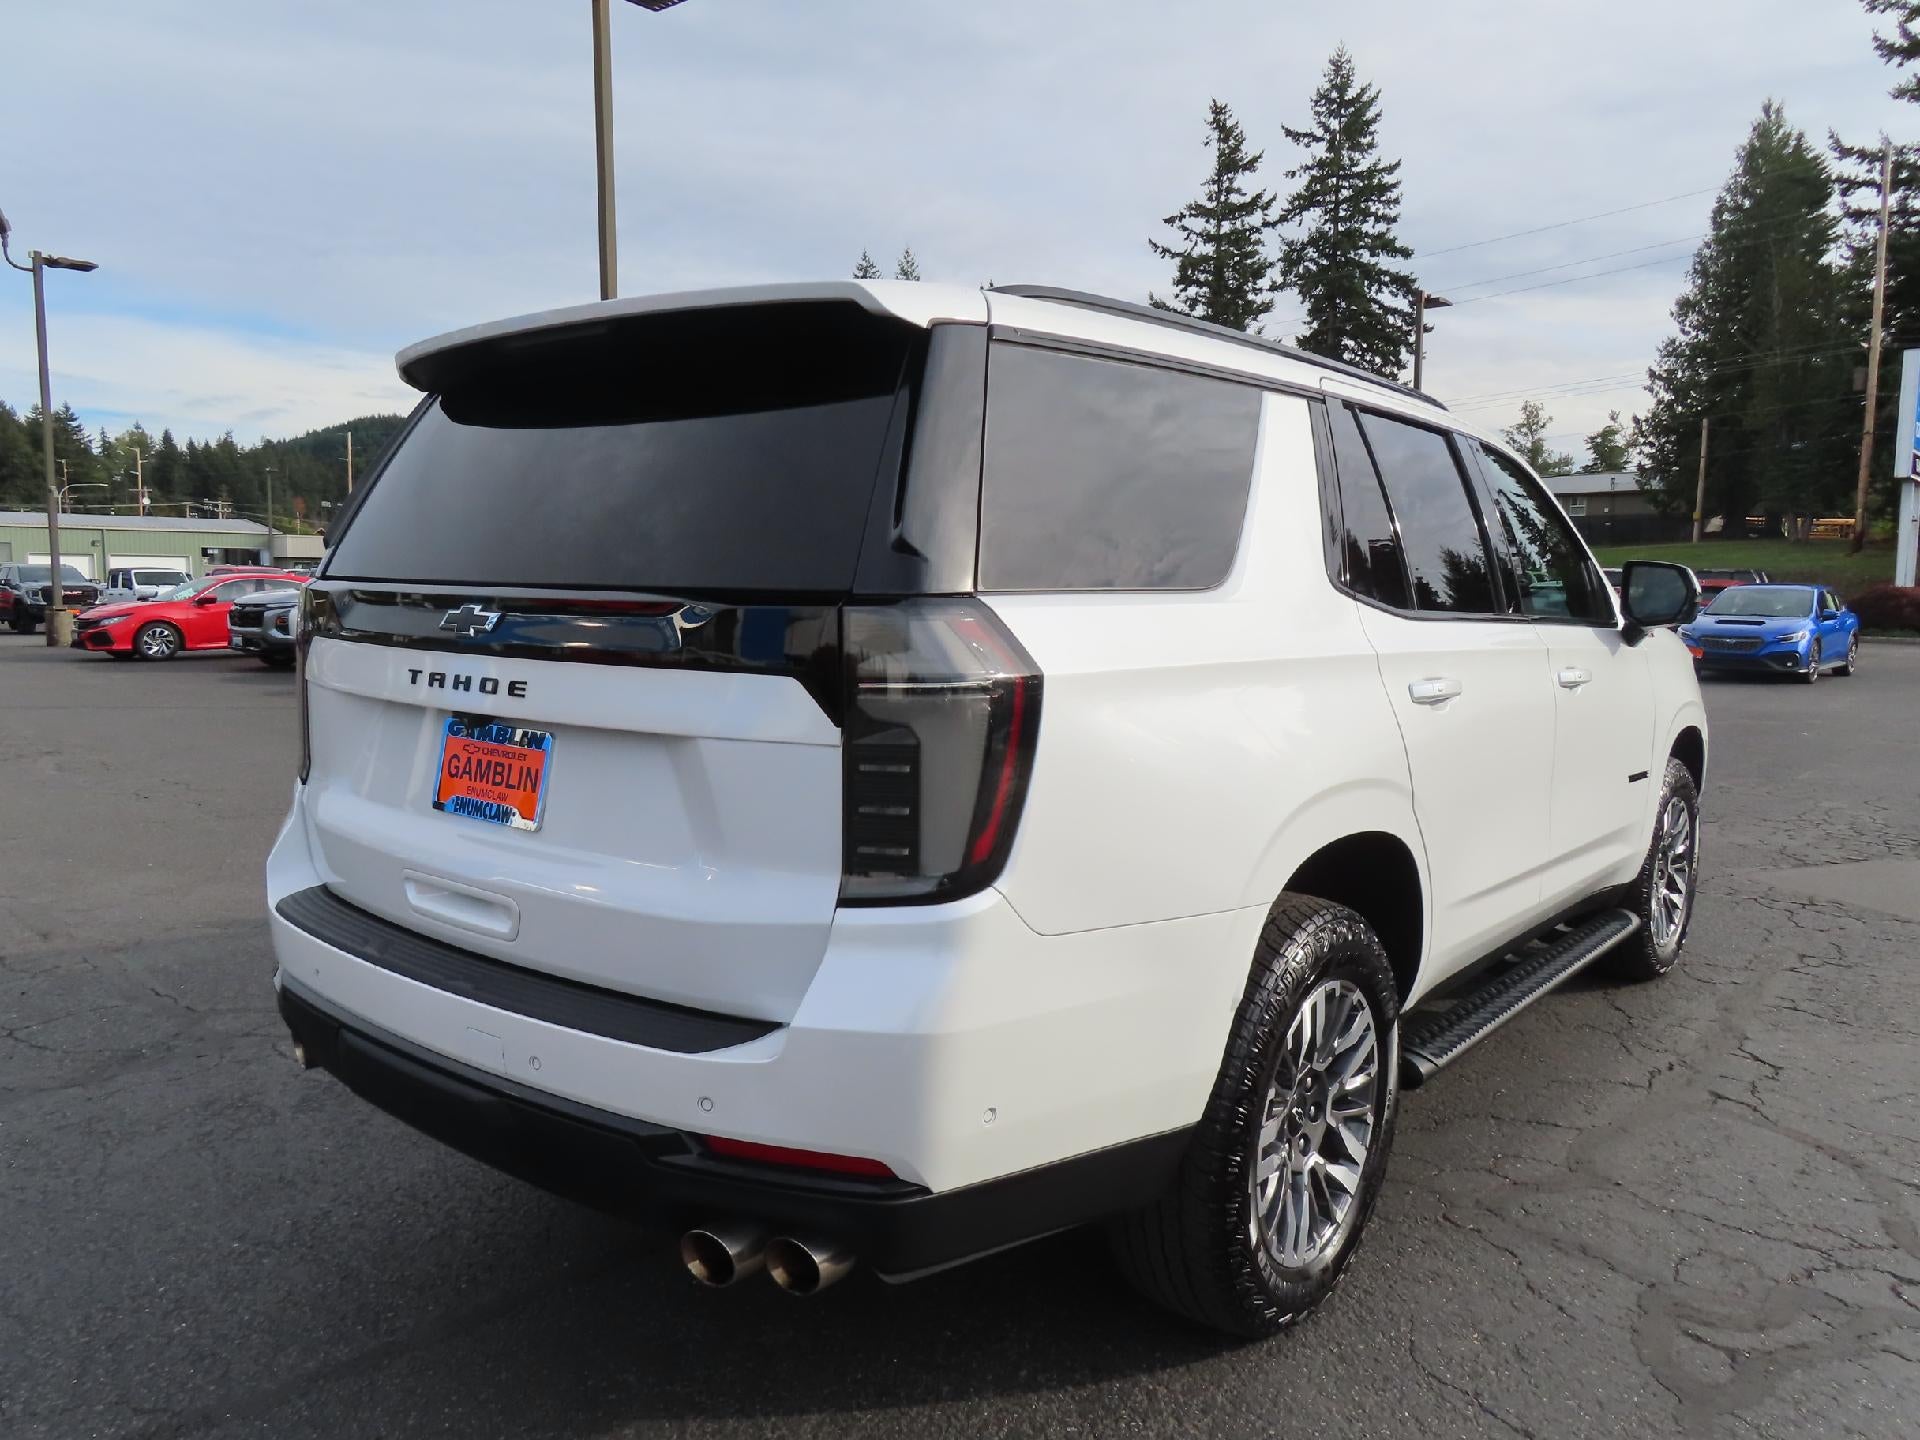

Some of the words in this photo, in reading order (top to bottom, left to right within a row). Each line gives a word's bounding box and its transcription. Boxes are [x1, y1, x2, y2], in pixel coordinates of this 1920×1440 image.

[408, 669, 528, 698] TAHOE
[482, 747, 527, 761] CHEVROLET
[447, 754, 539, 793] GAMBLIN
[466, 785, 509, 802] ENUMCLAW
